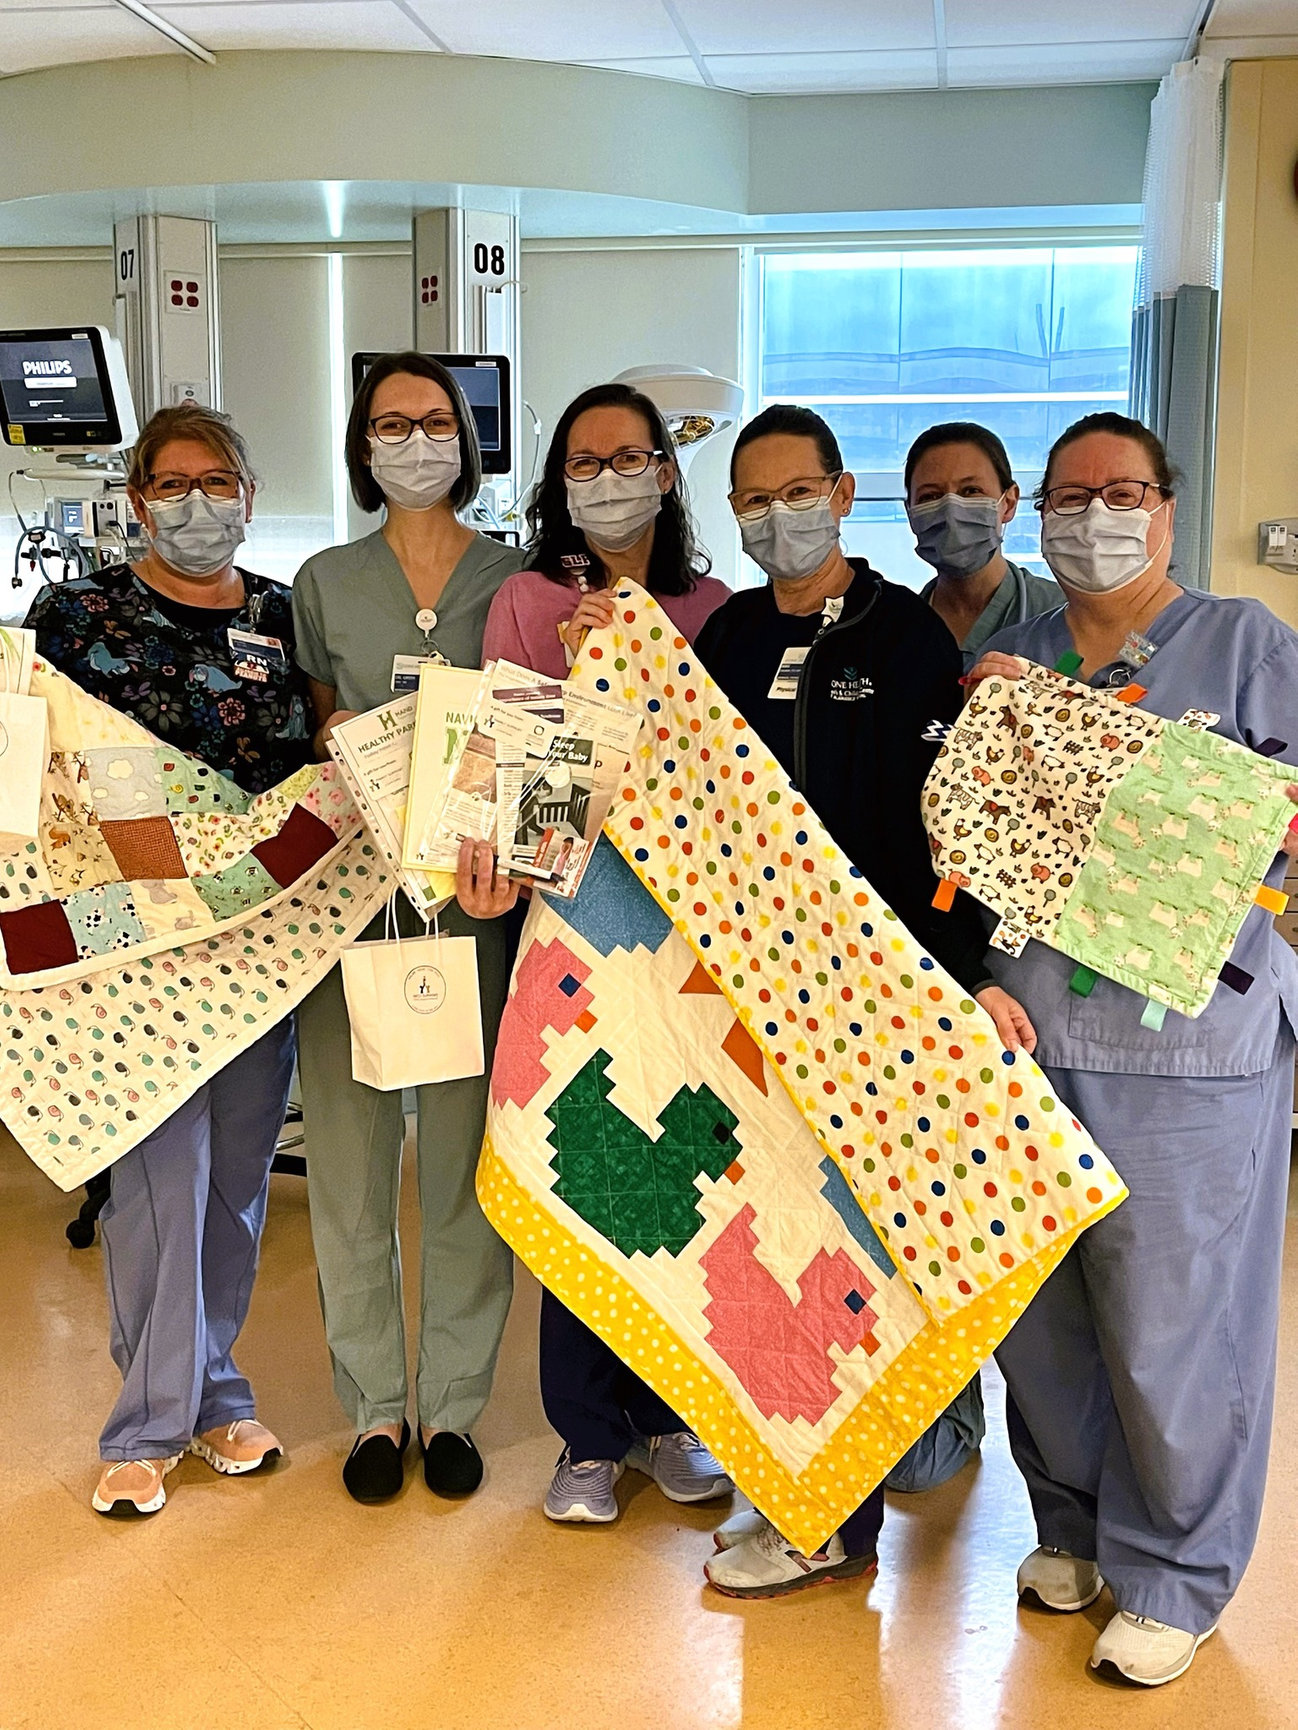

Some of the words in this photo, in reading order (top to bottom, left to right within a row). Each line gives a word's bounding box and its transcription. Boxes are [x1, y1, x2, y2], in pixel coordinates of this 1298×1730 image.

[121, 248, 135, 281] 07
[474, 243, 505, 276] 08
[22, 360, 73, 375] PHILIPS
[246, 654, 268, 667] RN
[831, 680, 847, 689] ONE
[445, 711, 477, 725] NAVI
[358, 731, 395, 753] HEALTHY
[552, 739, 575, 751] Sleep
[568, 752, 589, 763] Baby
